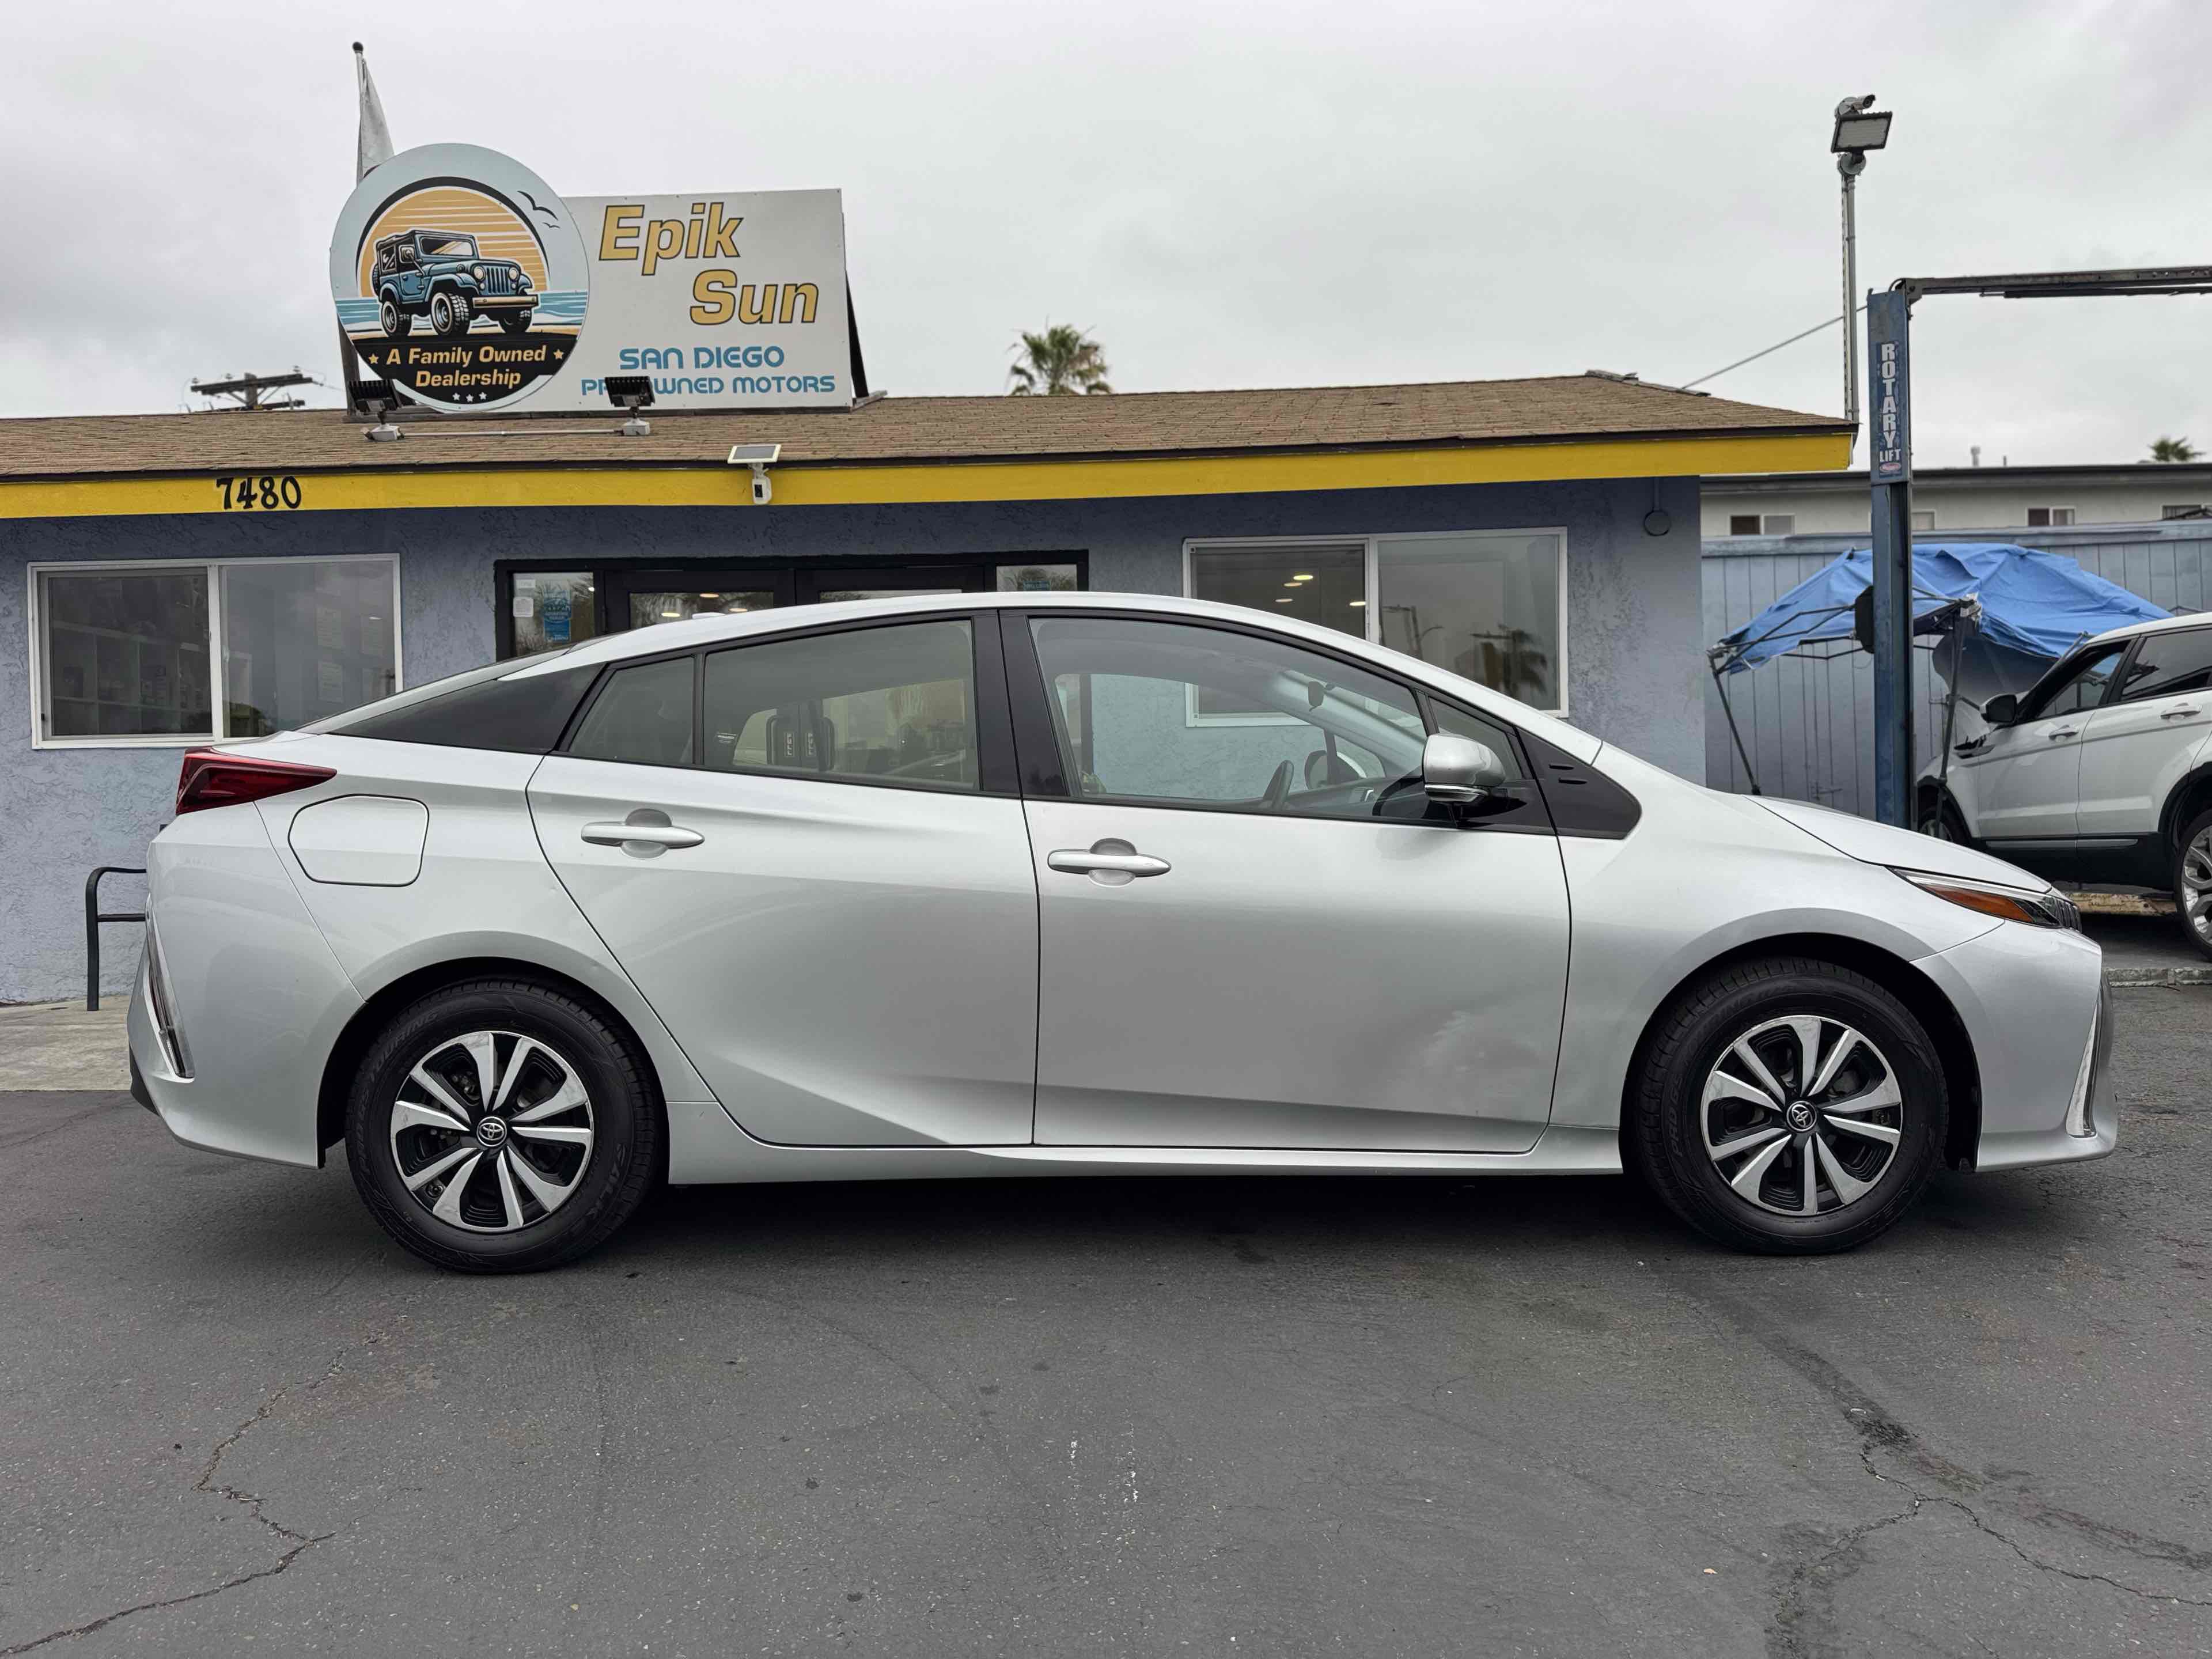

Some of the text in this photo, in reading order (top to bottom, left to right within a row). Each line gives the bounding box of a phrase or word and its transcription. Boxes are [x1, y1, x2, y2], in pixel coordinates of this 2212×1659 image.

[599, 202, 744, 276] Epik
[690, 269, 819, 325] Sun
[387, 346, 547, 368] A Family Owned
[619, 346, 785, 370] SAN DIEGO
[415, 369, 521, 389] Dealership
[733, 376, 835, 393] MOTORS
[1881, 343, 1897, 448] ROTARY
[1880, 449, 1901, 463] LIFT
[216, 476, 301, 509] 7480
